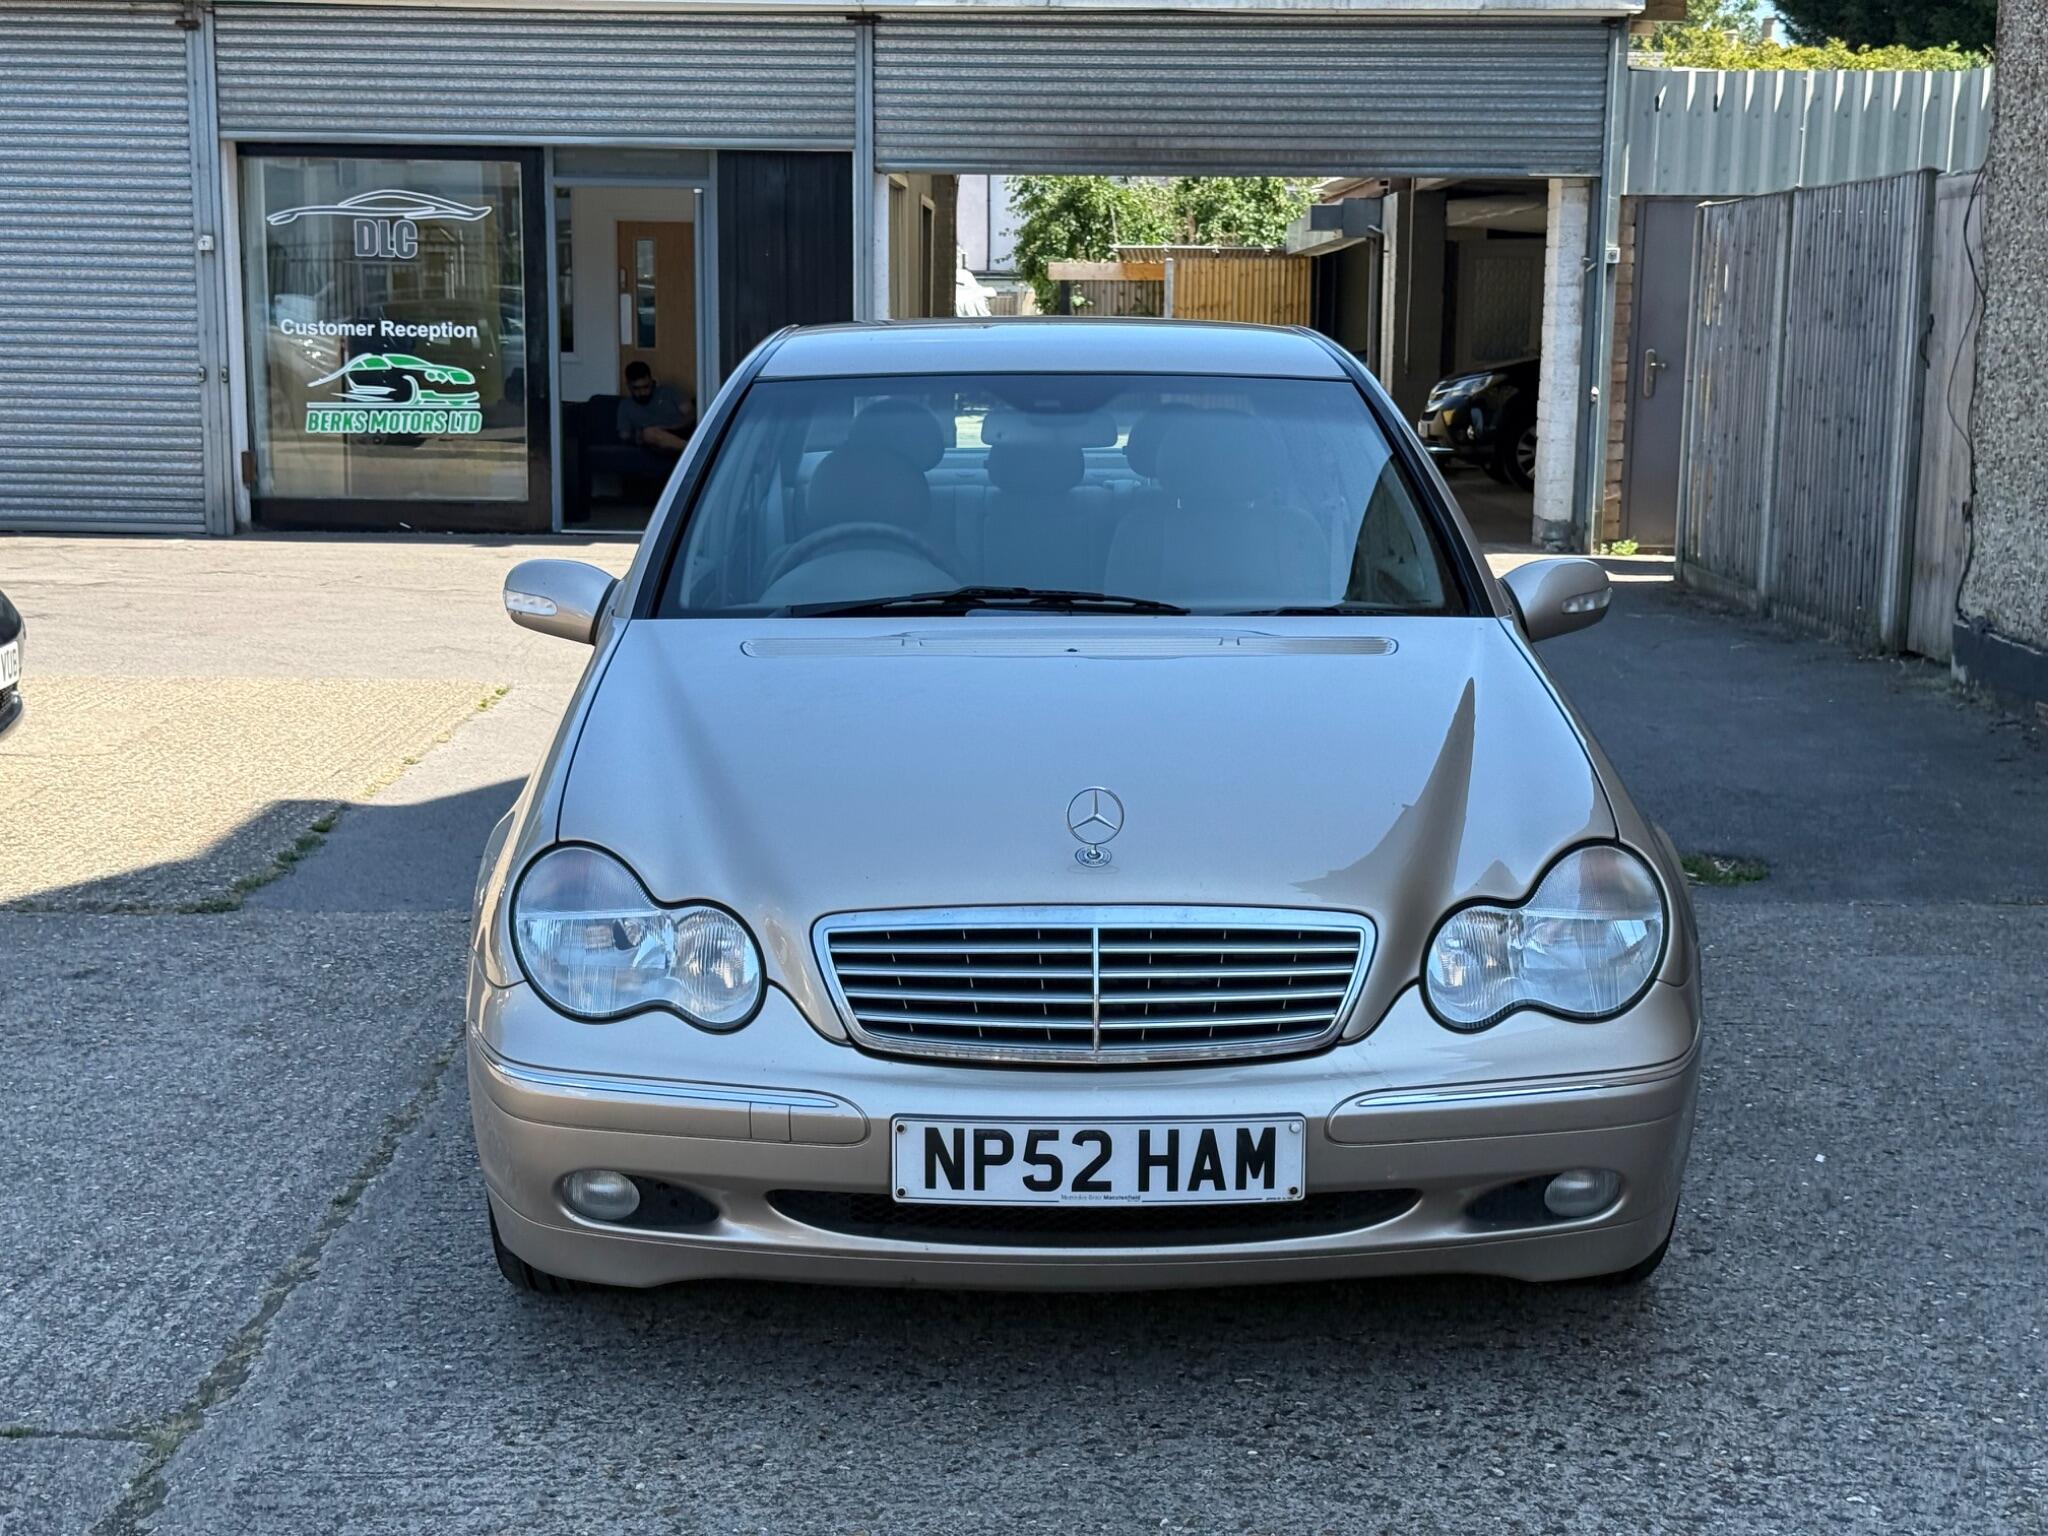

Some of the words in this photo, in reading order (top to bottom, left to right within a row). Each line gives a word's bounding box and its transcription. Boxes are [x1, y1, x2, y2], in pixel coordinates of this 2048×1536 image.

[354, 219, 418, 259] DLC
[280, 318, 375, 337] Customer
[381, 320, 478, 342] Reception
[306, 411, 368, 433] BERKS
[369, 411, 447, 434] MOTORS
[448, 411, 482, 434] LTD
[924, 1127, 1113, 1192] NP52
[1138, 1127, 1277, 1192] HAM
